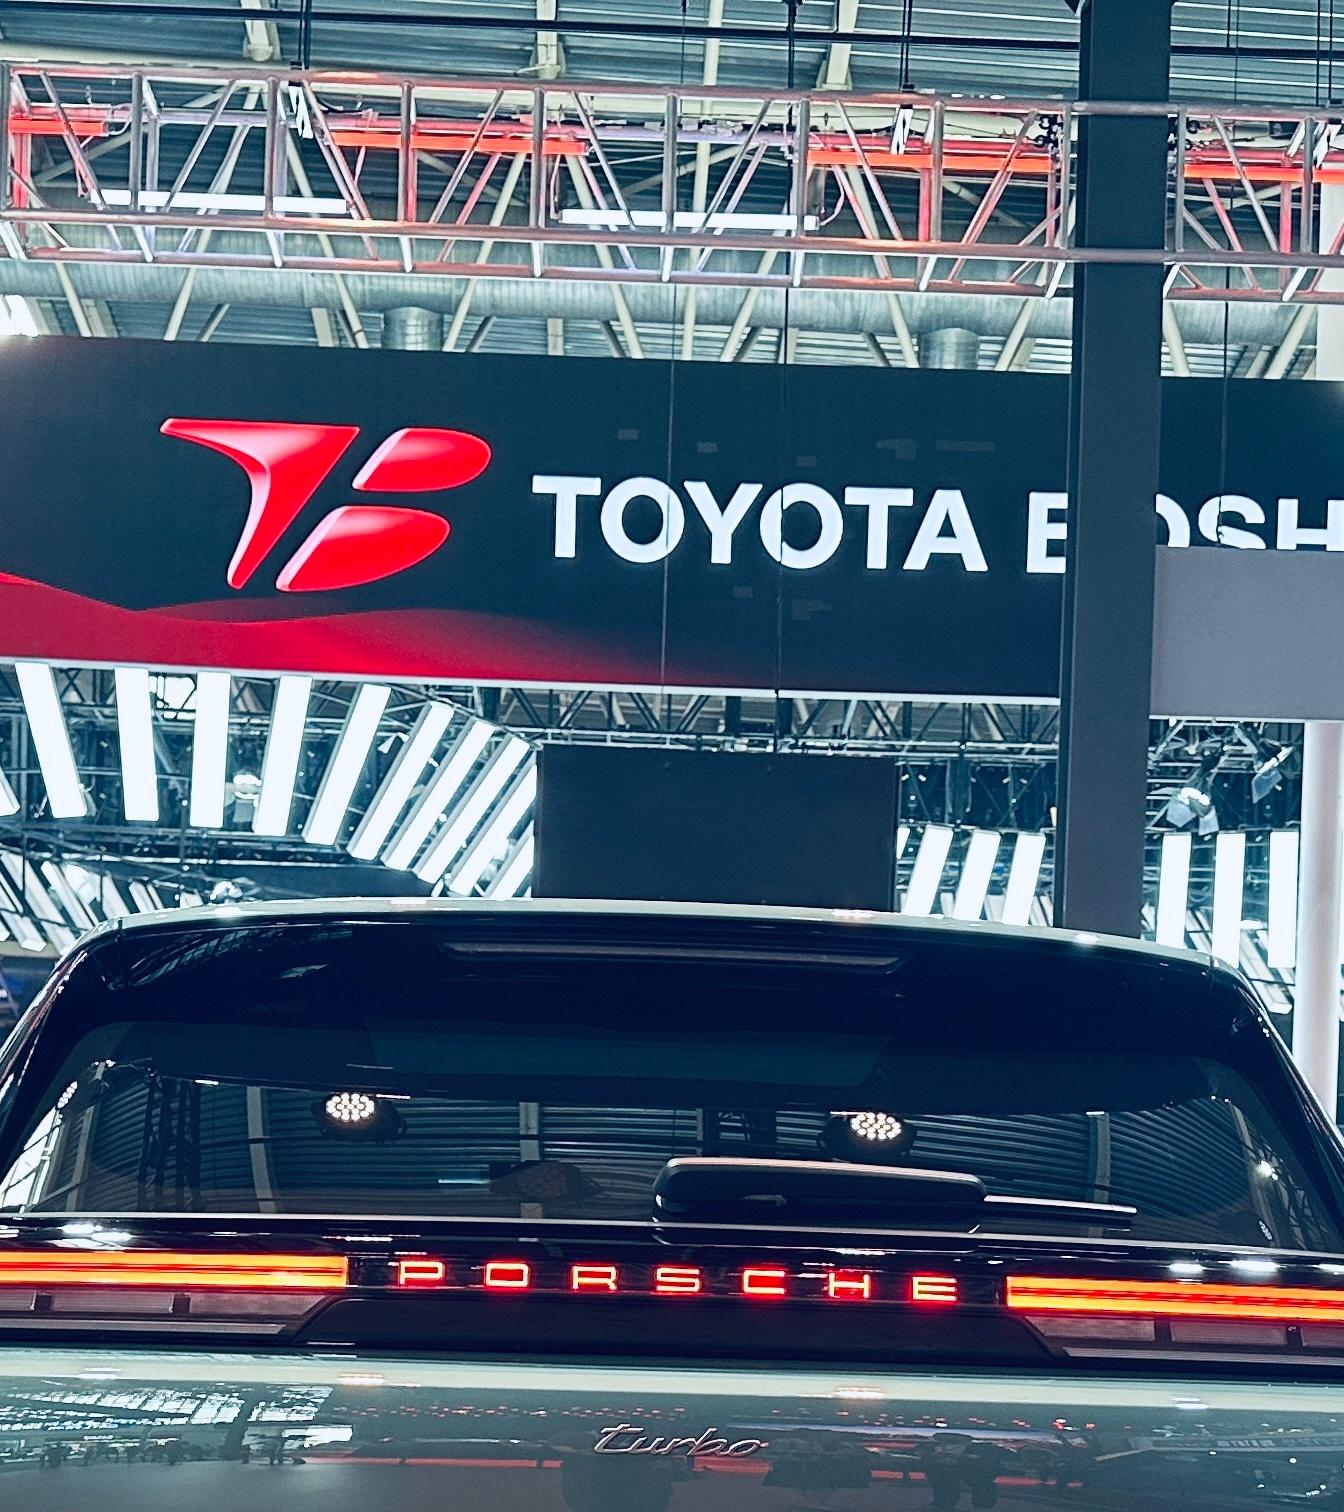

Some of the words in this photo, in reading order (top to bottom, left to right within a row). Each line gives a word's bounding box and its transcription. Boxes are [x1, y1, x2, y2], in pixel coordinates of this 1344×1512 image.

[532, 474, 989, 573] TOYOTA
[397, 1259, 958, 1303] PORSCHE
[593, 1422, 770, 1457] turbo
